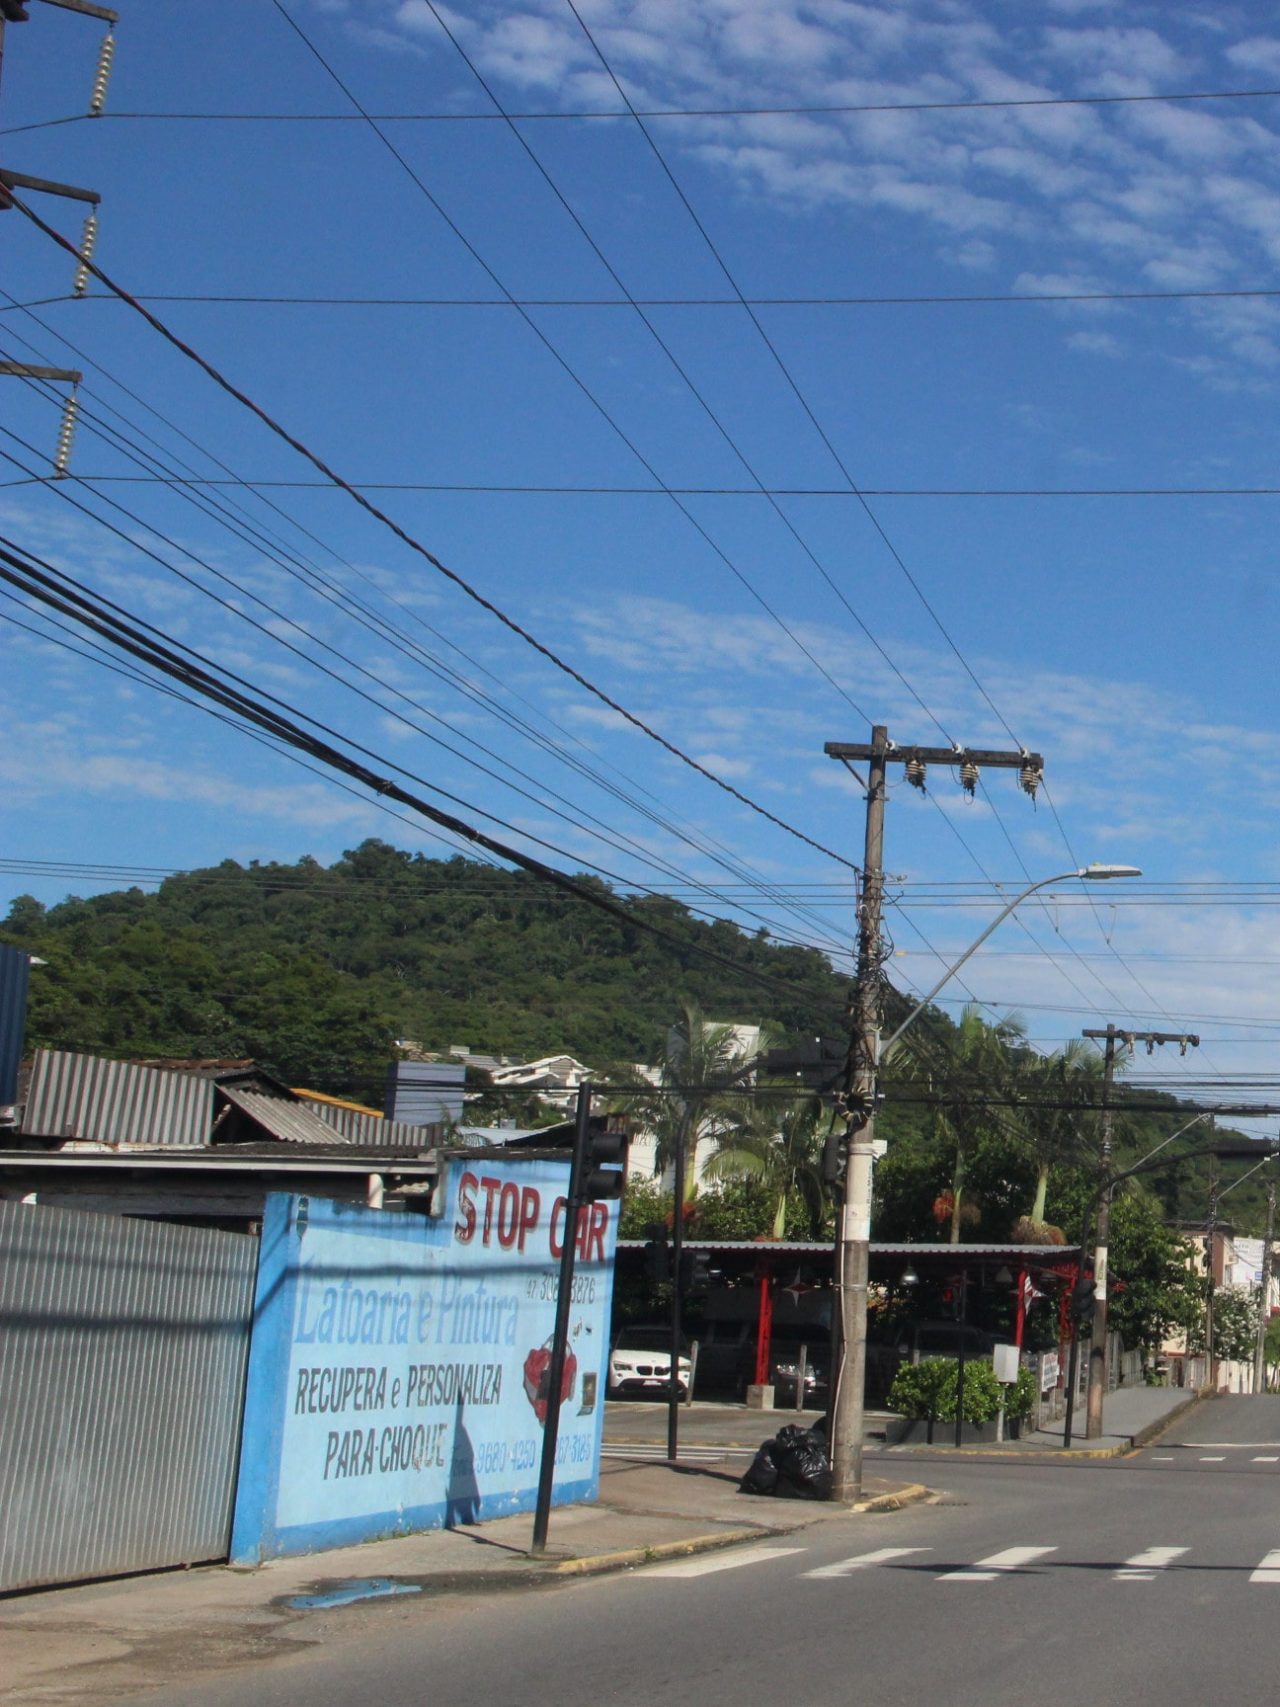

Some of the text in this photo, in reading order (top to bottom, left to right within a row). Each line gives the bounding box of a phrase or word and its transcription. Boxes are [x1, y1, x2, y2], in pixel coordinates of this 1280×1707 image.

[455, 1172, 540, 1252] STOP
[550, 1196, 608, 1262] CAR
[294, 1266, 518, 1345] Latoaria e Pintura
[295, 1364, 502, 1414] RECUPERA e PERSONALIZA
